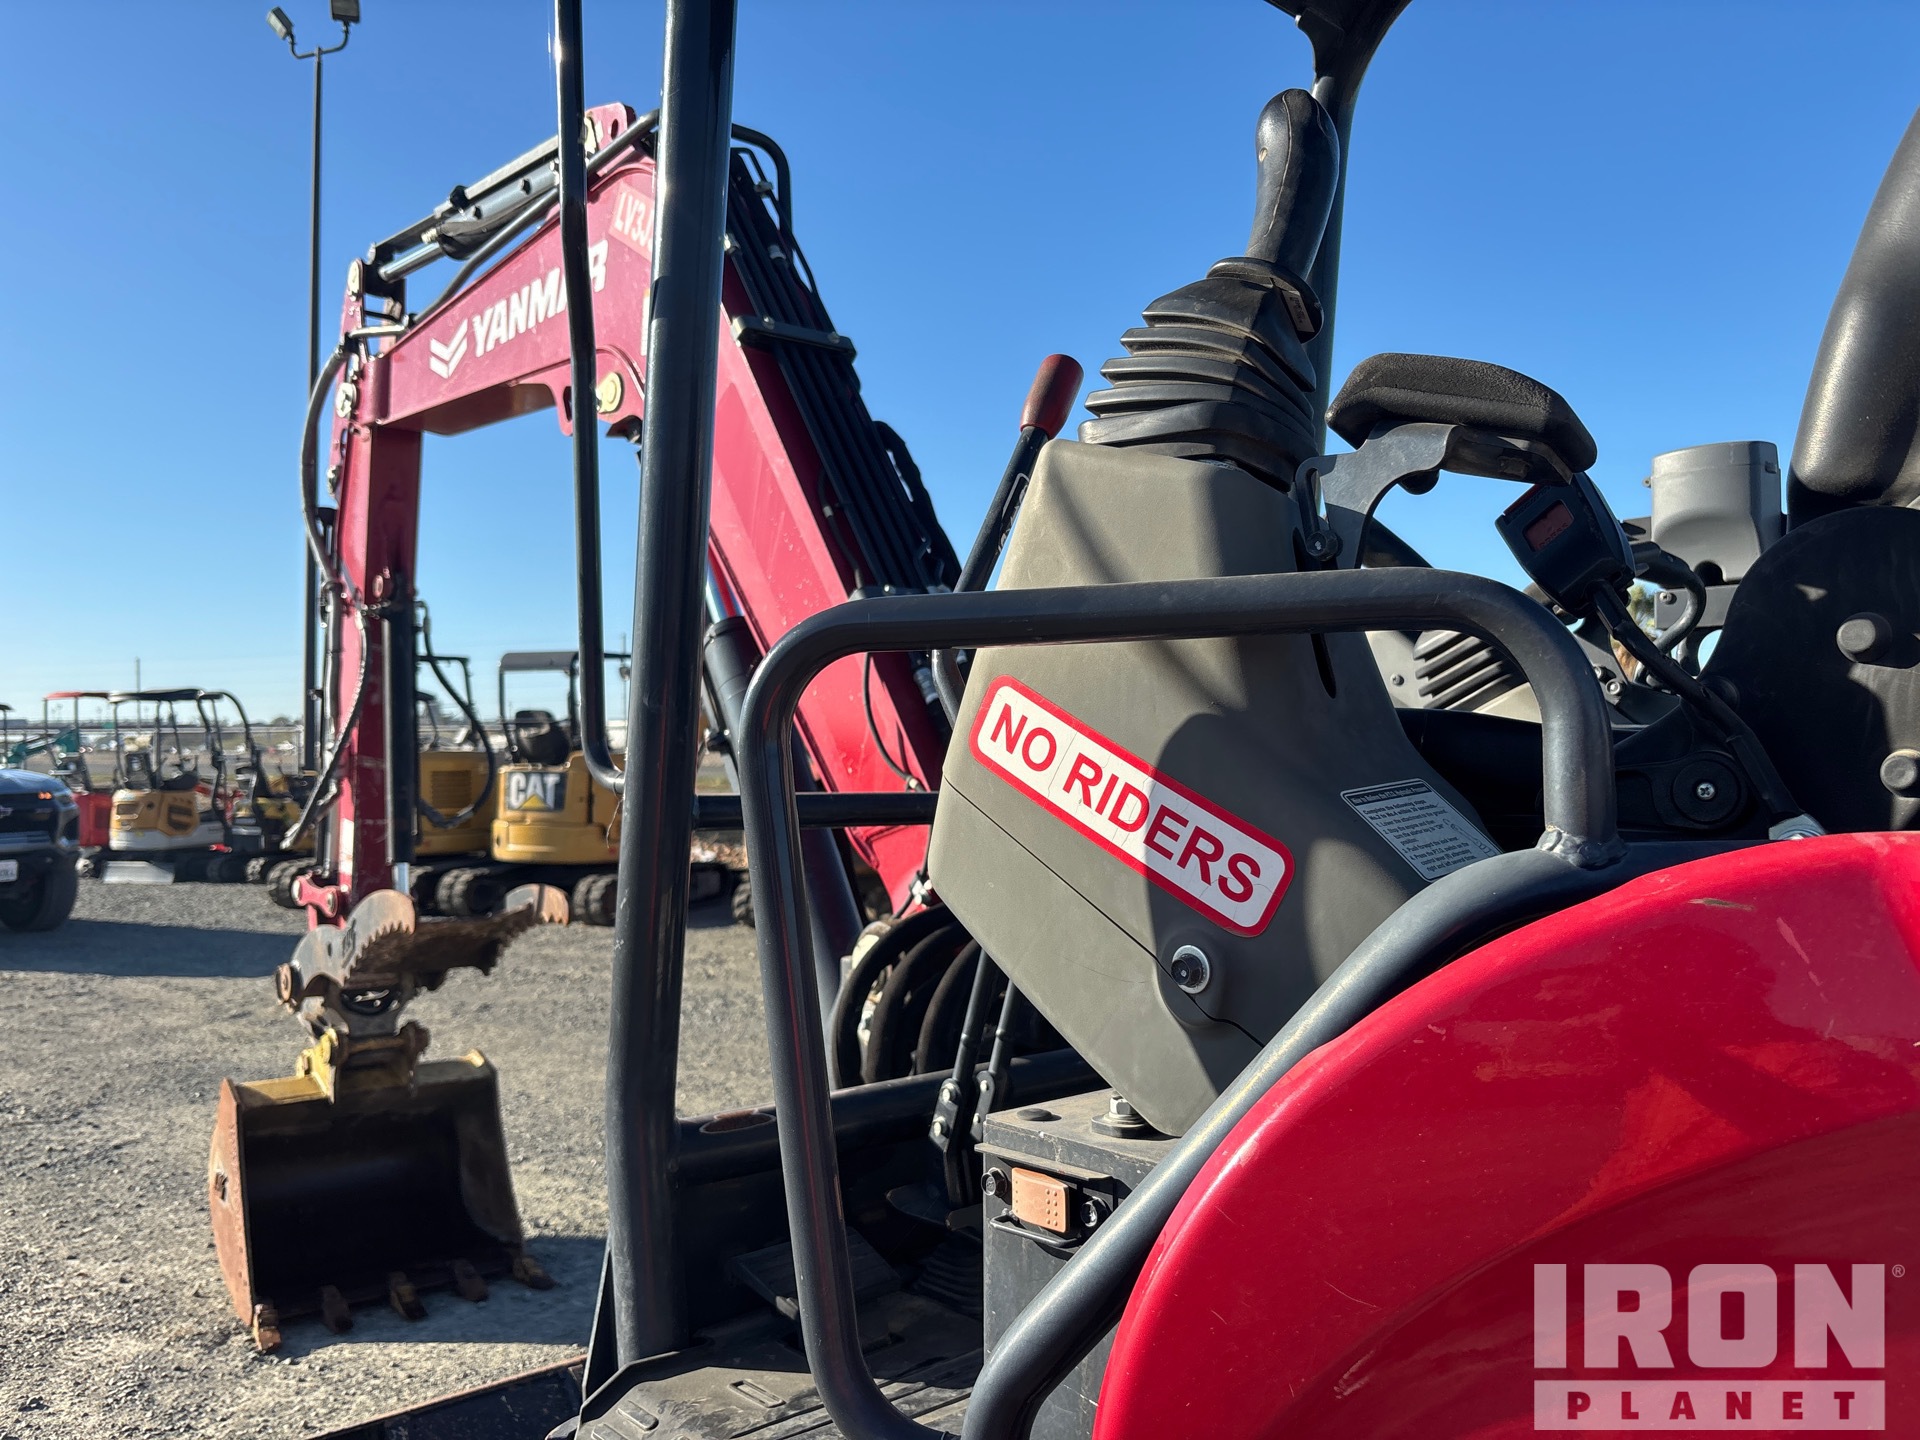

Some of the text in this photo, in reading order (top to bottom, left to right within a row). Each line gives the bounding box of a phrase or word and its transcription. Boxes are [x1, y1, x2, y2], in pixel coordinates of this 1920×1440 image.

[614, 190, 655, 253] LV3J
[471, 239, 609, 358] YANMR
[509, 772, 561, 810] CAT
[990, 703, 1262, 903] NO RIDERS
